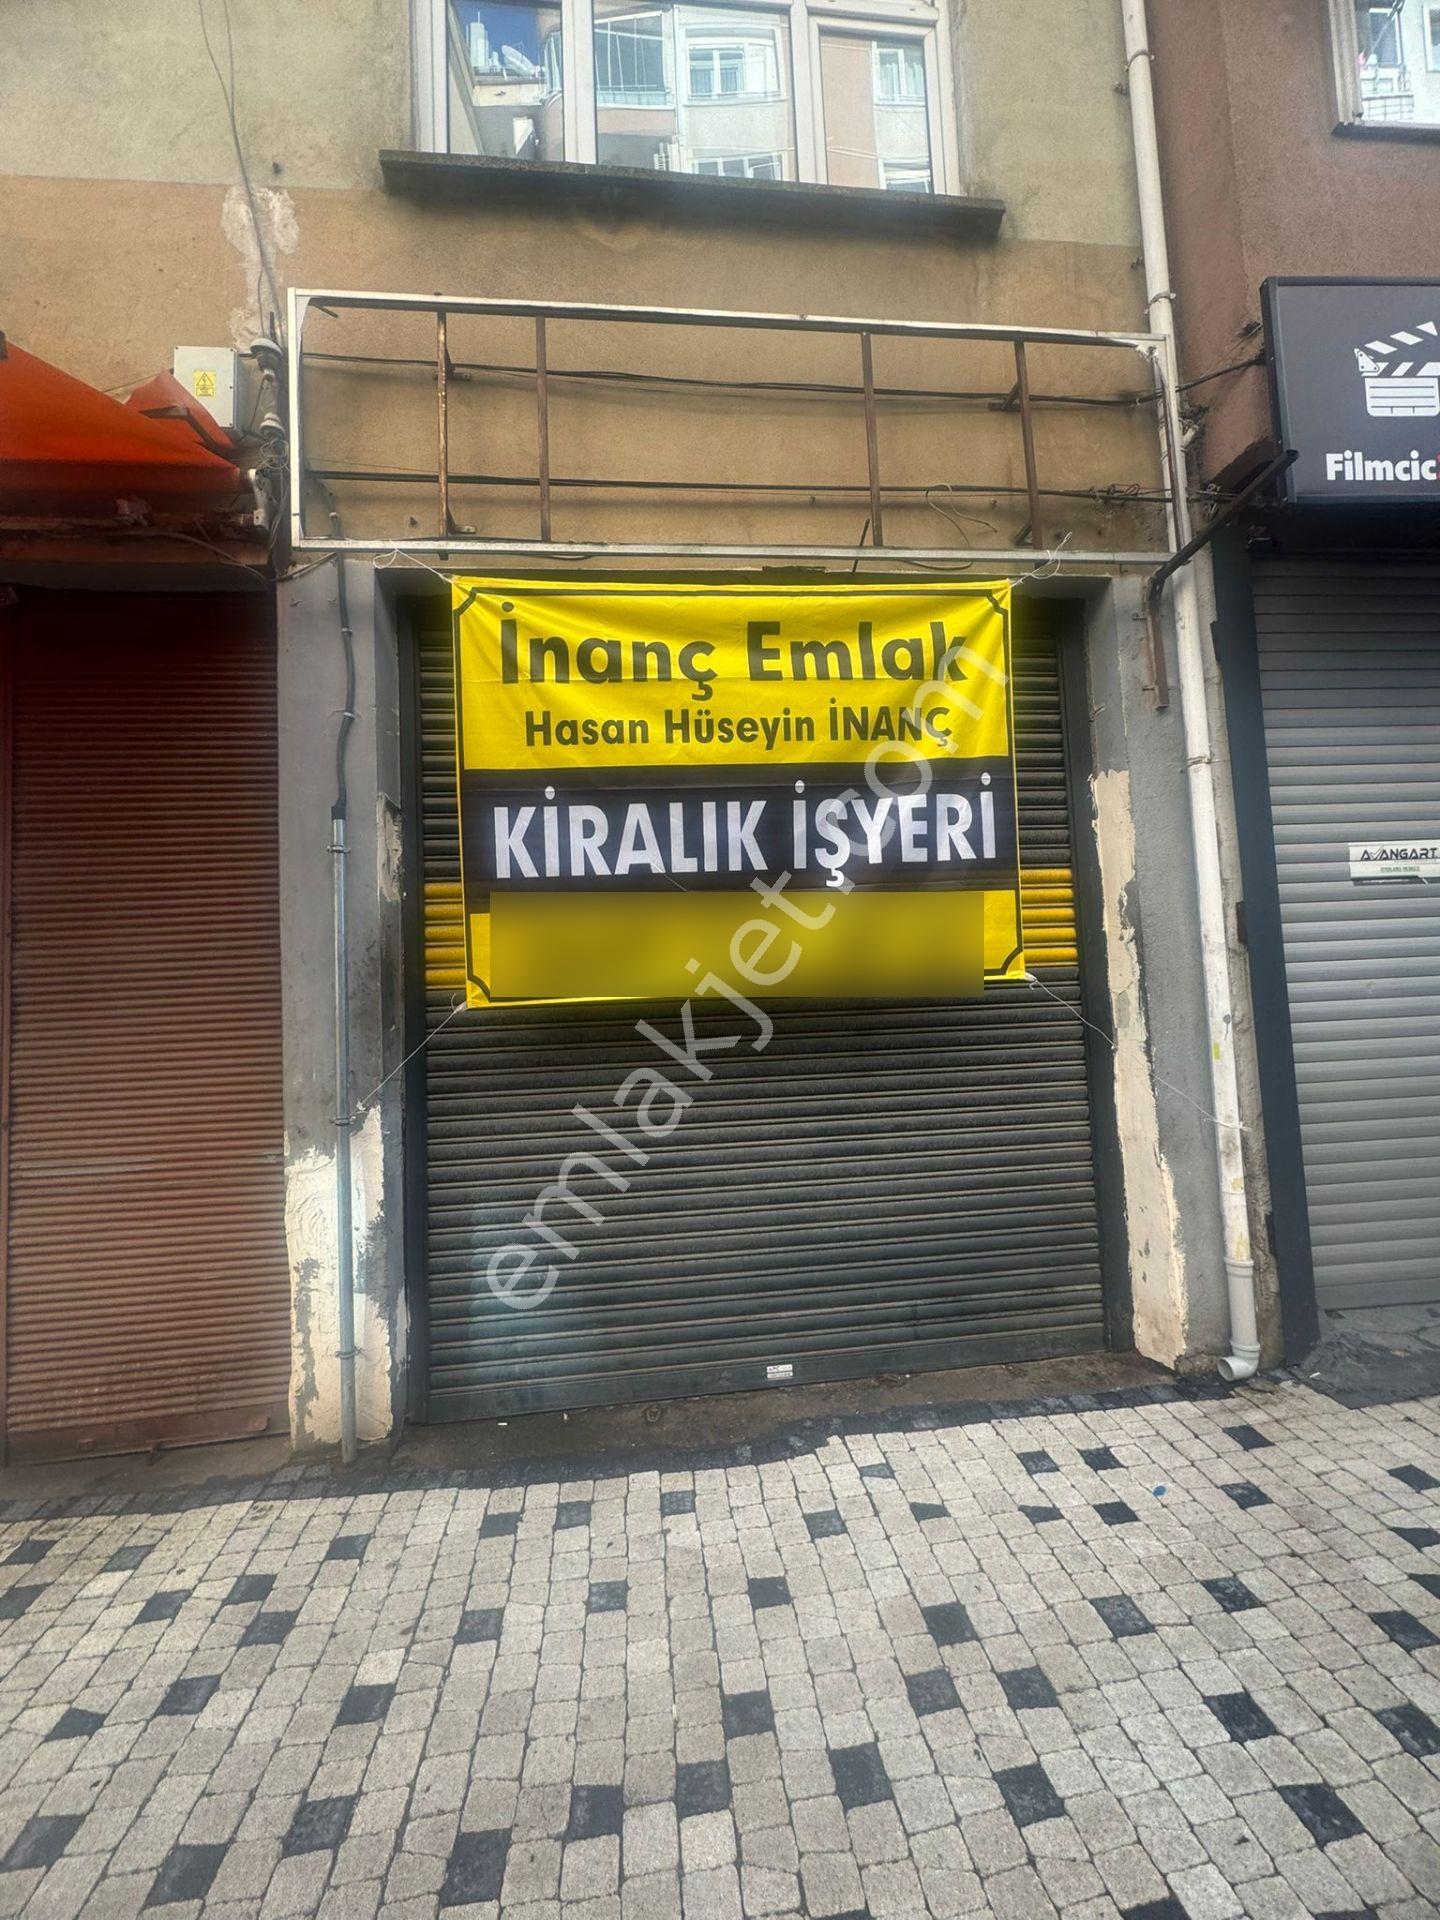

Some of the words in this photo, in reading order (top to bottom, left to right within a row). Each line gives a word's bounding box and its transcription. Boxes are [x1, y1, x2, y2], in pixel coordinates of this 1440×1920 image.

[1326, 449, 1440, 481] Filmcic
[501, 601, 719, 701] İnanç
[746, 620, 970, 684] Emlak
[525, 710, 650, 747] Hasan
[664, 707, 815, 750] Hüseyin
[829, 697, 952, 747] İNANÇ
[493, 785, 769, 880] KİRALIK
[794, 772, 998, 888] İŞYERİ
